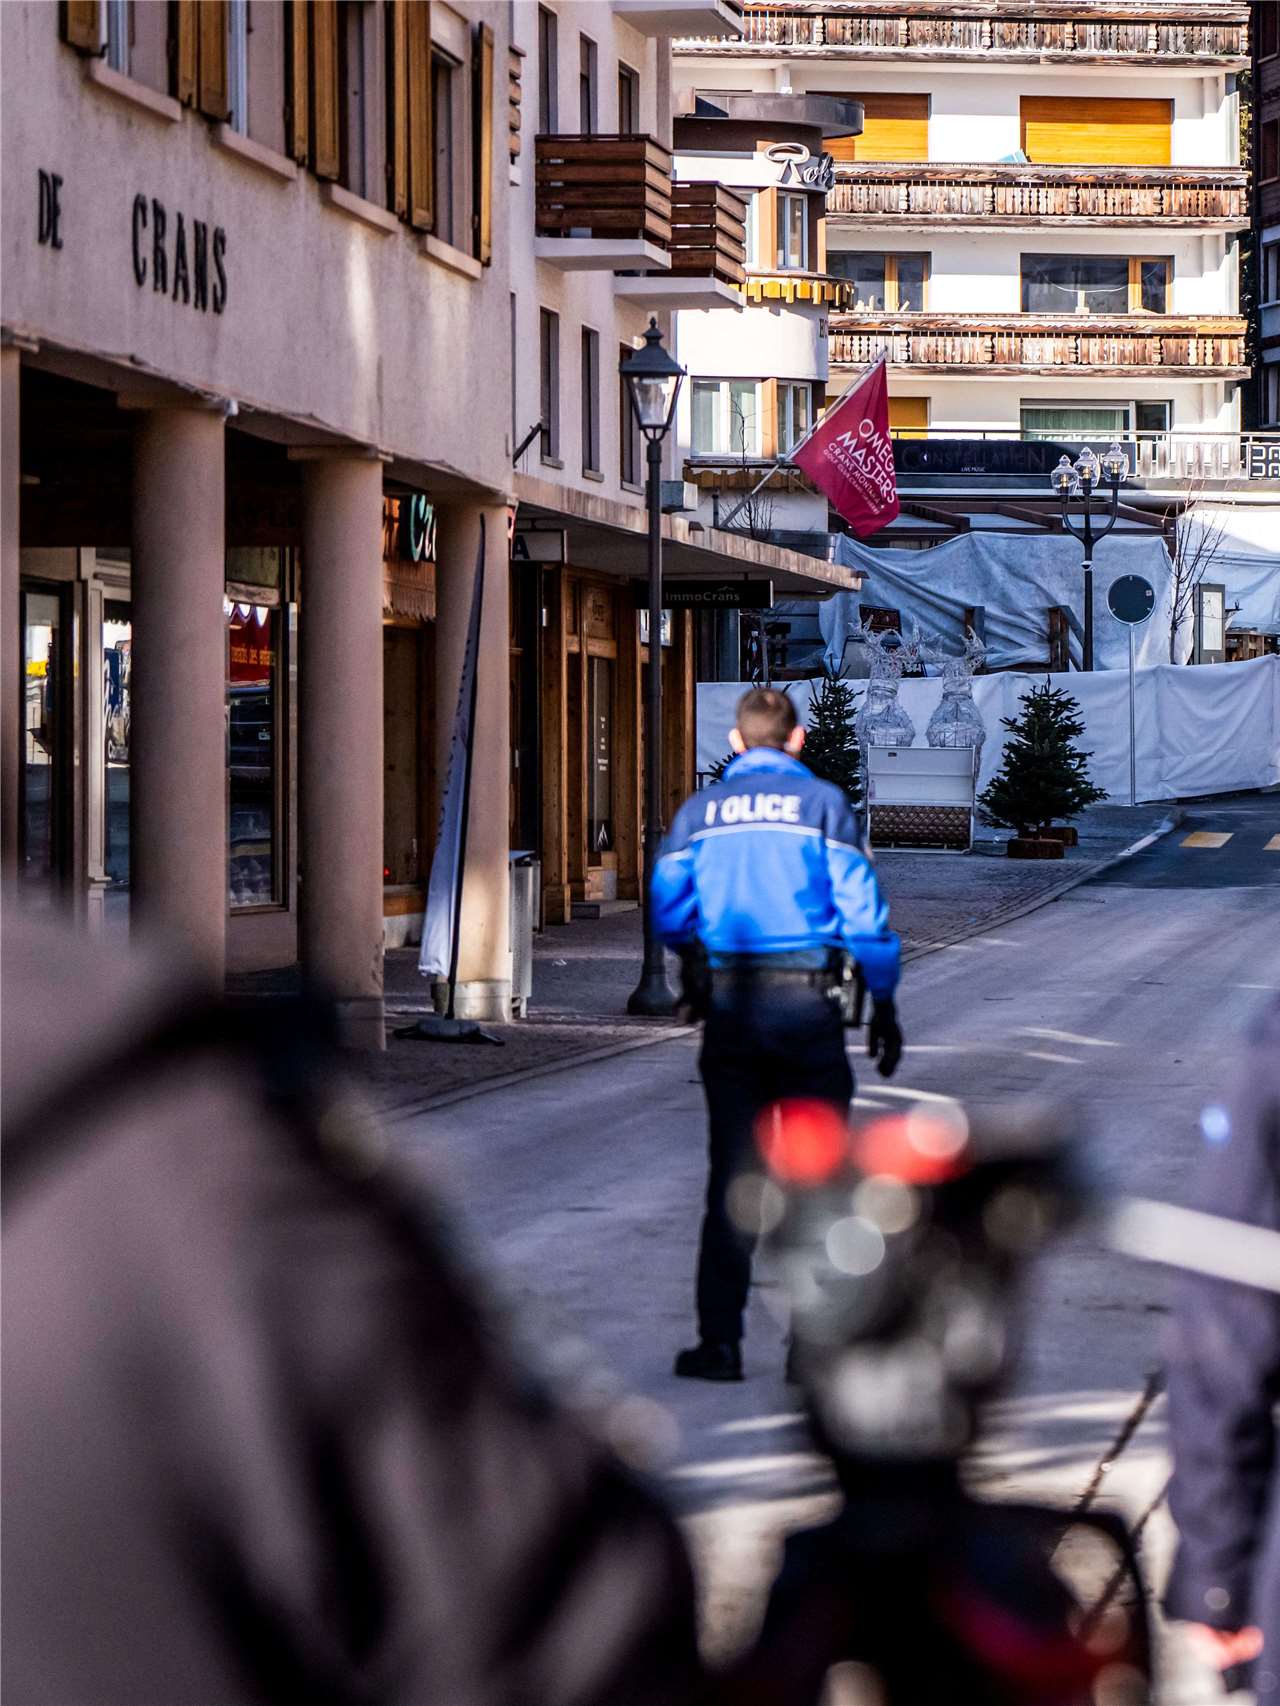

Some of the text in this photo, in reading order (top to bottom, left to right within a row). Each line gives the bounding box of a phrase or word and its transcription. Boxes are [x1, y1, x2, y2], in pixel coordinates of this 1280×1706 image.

[38, 168, 227, 315] DE CRANS
[828, 442, 855, 472] CRANS
[836, 431, 896, 503] MASTERS
[858, 418, 896, 477] OMEG
